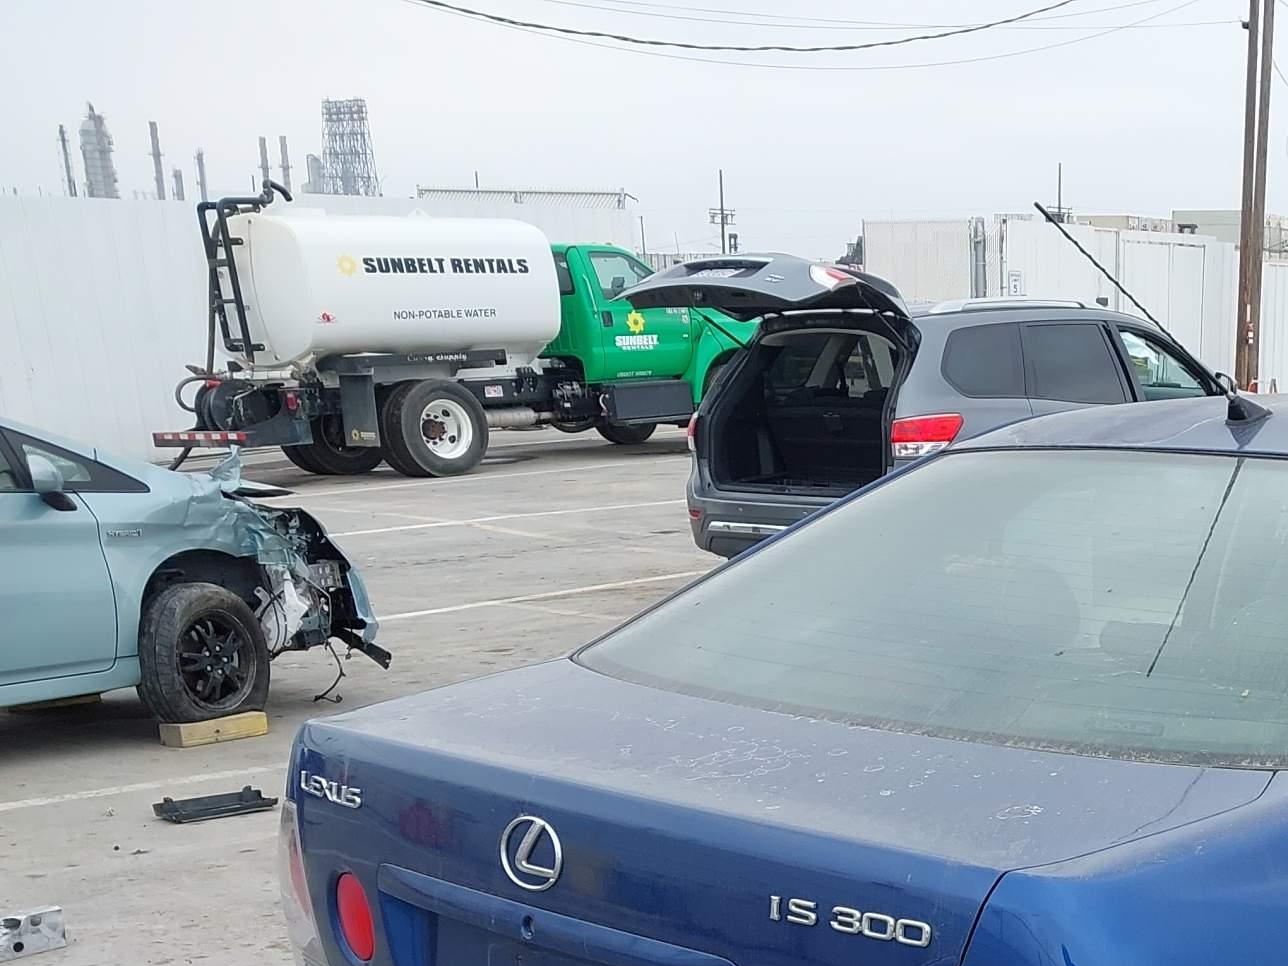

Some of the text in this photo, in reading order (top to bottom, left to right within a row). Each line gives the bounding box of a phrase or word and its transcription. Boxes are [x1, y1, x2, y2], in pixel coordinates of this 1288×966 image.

[362, 257, 529, 274] SUNBELT RENTALS
[393, 308, 497, 320] NON-POTABLE WATER
[615, 334, 659, 346] SUNBELT
[300, 770, 362, 809] LEXUS
[769, 895, 932, 948] IS 300
